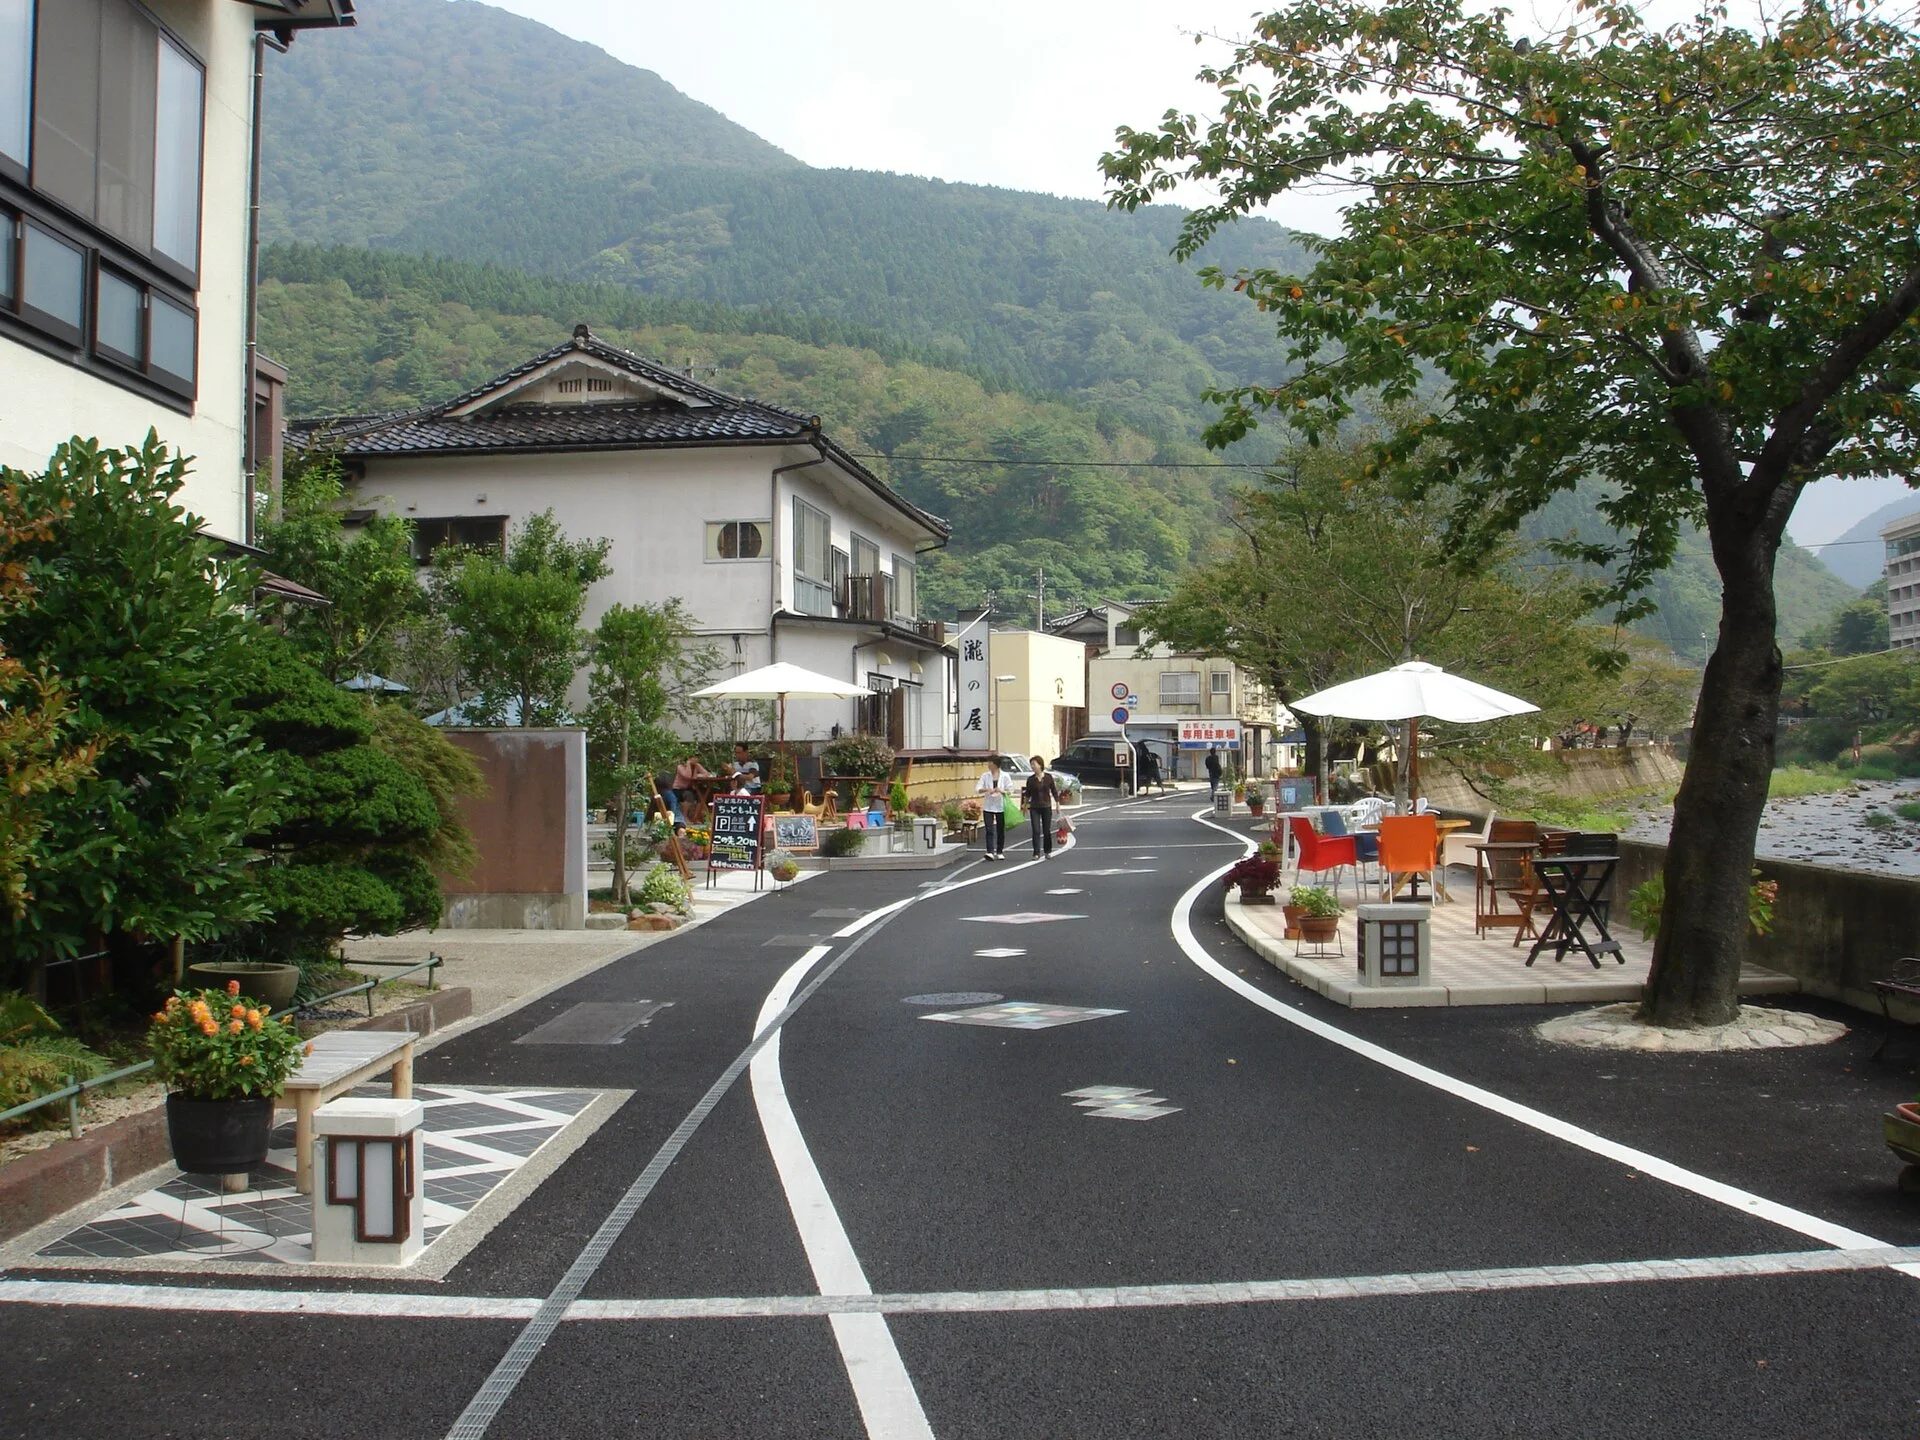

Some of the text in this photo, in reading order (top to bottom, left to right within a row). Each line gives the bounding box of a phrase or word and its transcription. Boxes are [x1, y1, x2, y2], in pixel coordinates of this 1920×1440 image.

[963, 639, 984, 731] 瀧の屋
[1115, 687, 1125, 696] 30
[1183, 729, 1236, 740] 専用駐車場
[1118, 755, 1126, 763] P
[719, 818, 728, 829] P
